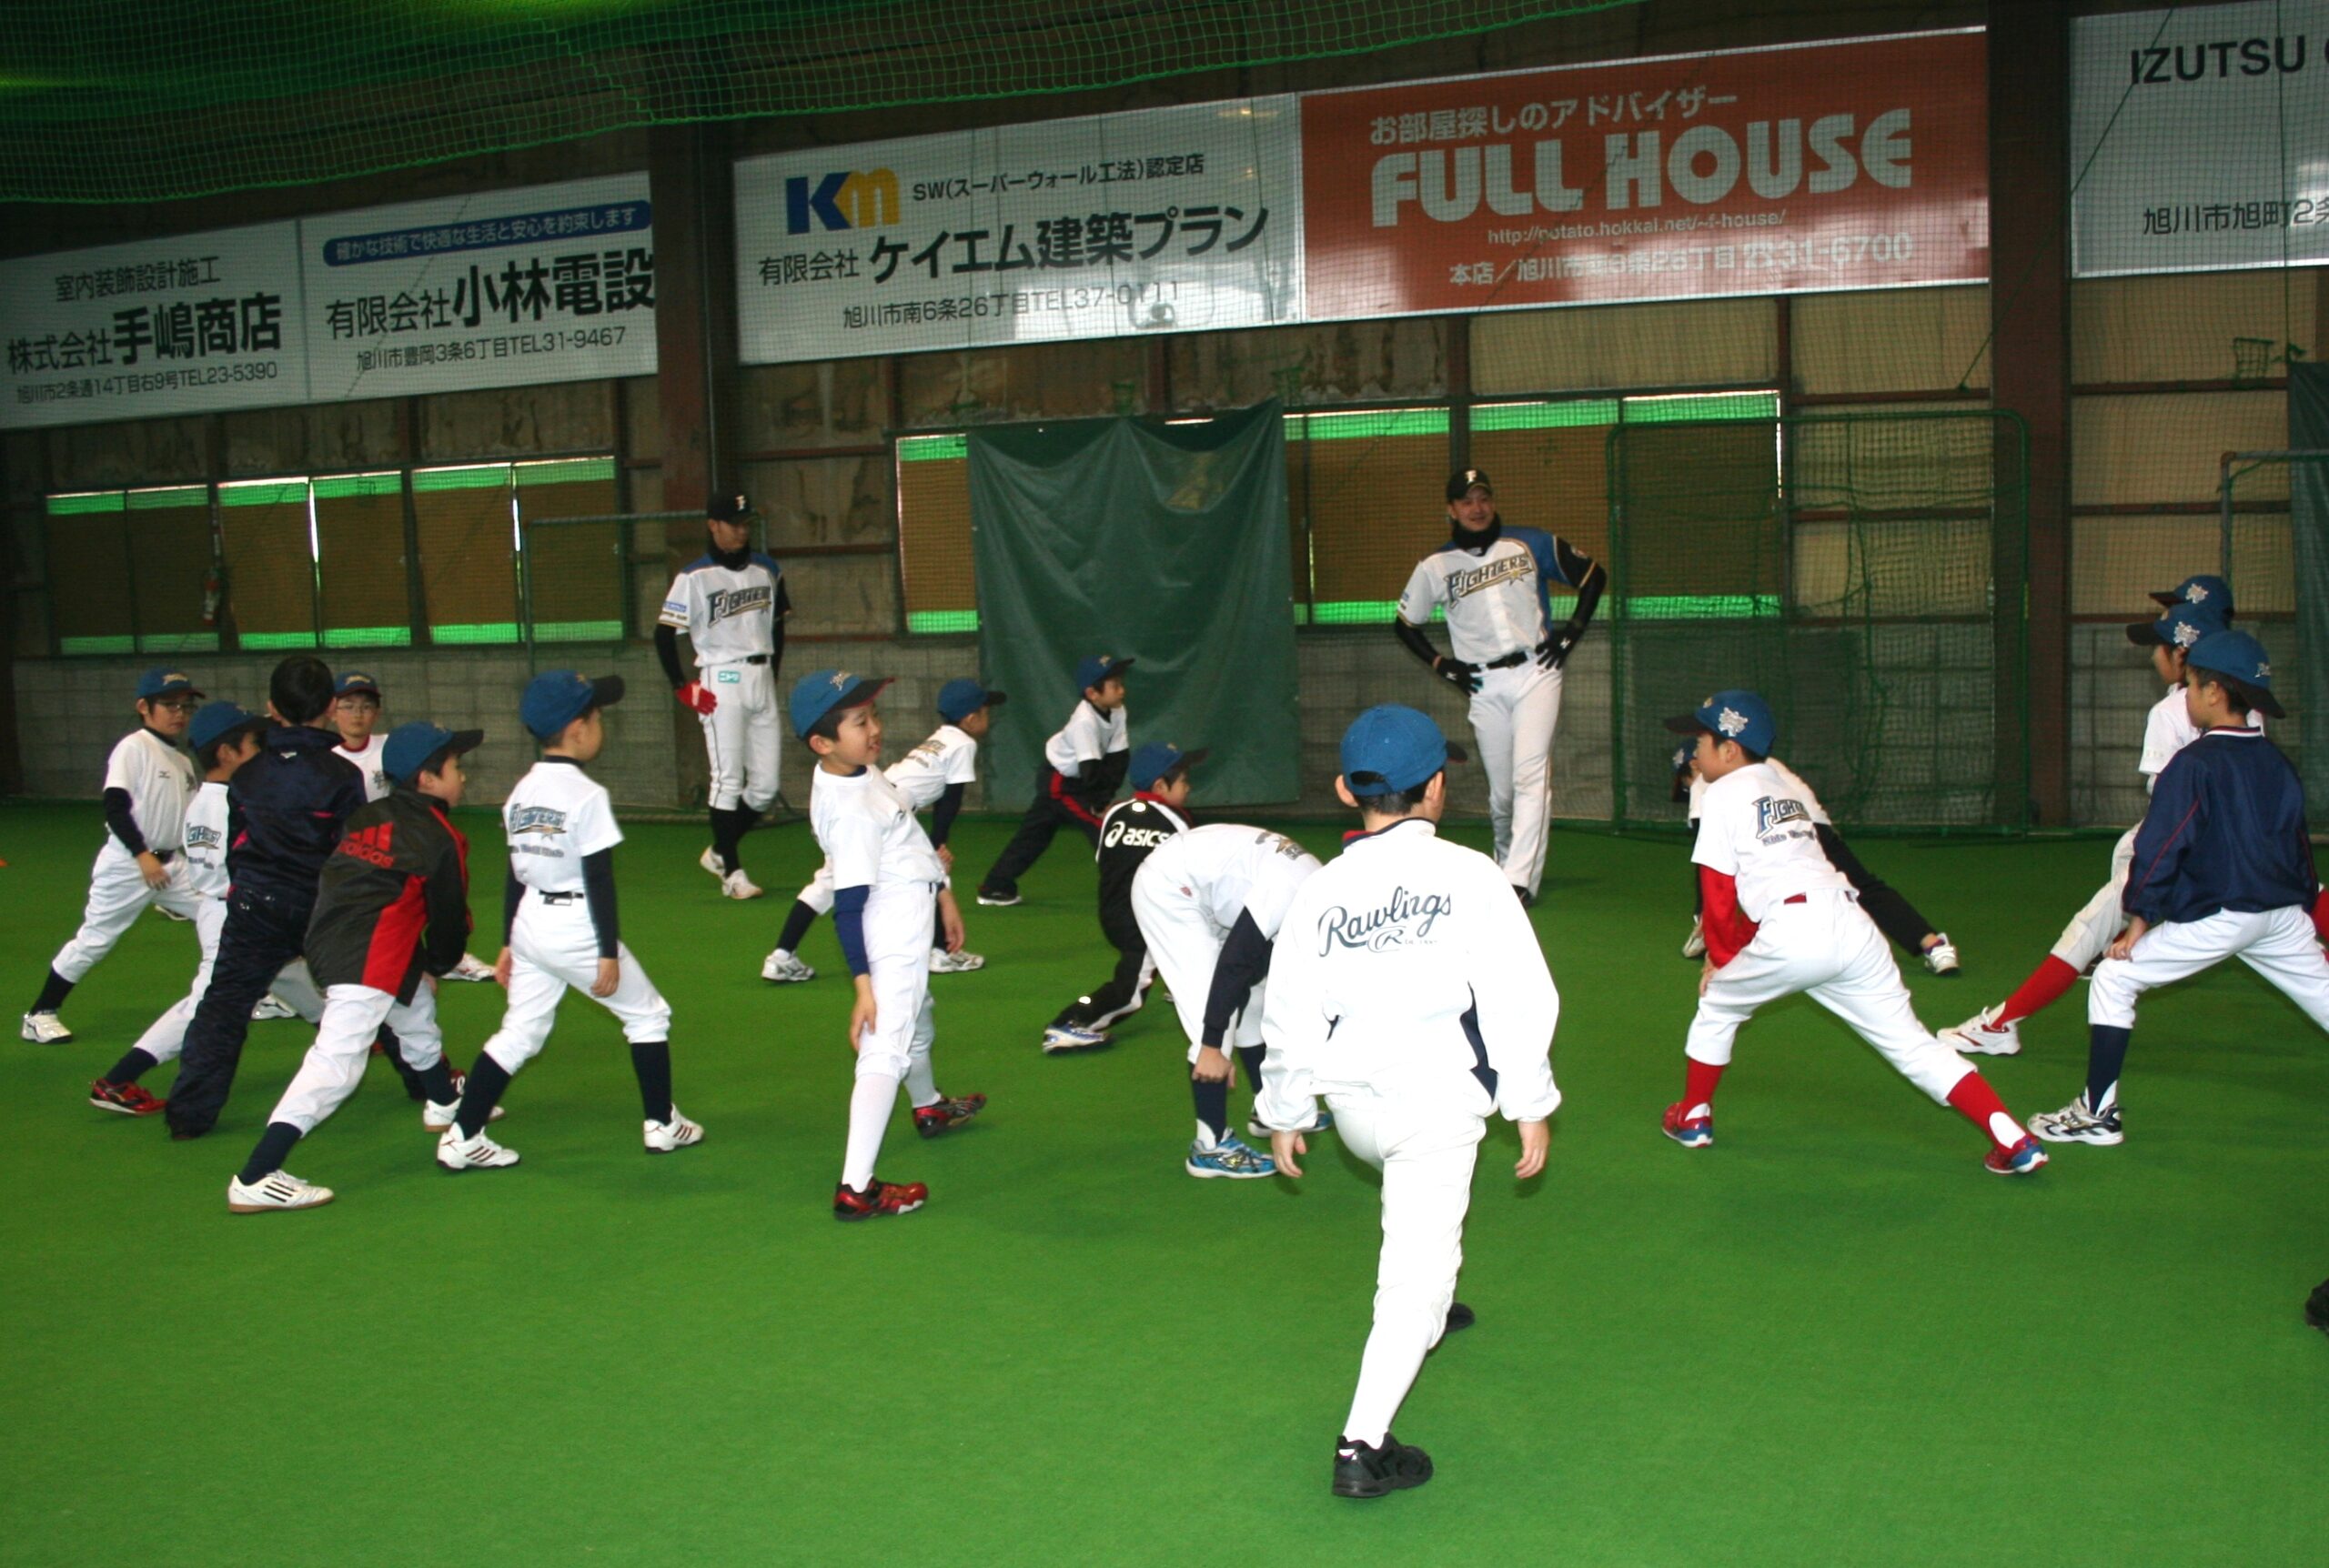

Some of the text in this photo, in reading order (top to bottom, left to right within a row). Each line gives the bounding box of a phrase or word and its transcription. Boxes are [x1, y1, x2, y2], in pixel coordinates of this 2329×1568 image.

[2132, 35, 2305, 84] IZUTSU
[1370, 86, 1737, 146] お部屋探しのアドバイザー
[912, 154, 1205, 201] SW(スーパーウォール工法)認定店
[1372, 108, 1911, 227] FULL HOUSE
[336, 207, 638, 262] 確かな技術で快適な生活と安心を約束します
[759, 206, 1268, 286] 有限会社 ケイエム建築プラン
[55, 256, 221, 302] 室内装飾設計施工
[357, 326, 627, 371] 旭川市豊岡3条6丁目TEL31-9467
[1317, 885, 1451, 957] Rawlings
